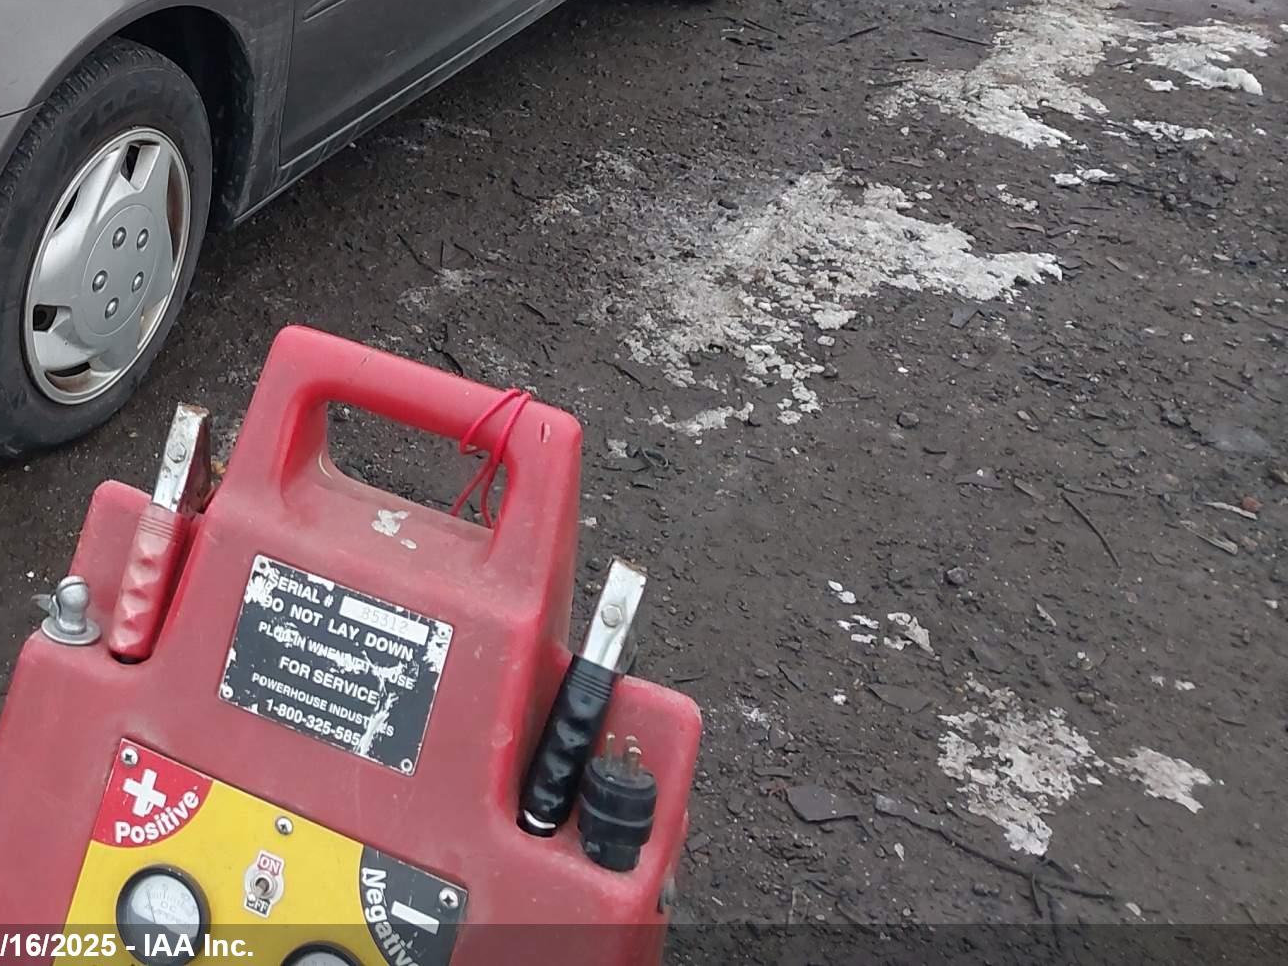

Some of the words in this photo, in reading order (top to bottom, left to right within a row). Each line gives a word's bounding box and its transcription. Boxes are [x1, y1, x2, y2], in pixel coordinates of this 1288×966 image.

[269, 574, 321, 604] SERIAL
[323, 594, 334, 608] #
[289, 604, 323, 626] NOT
[327, 618, 360, 641] LAY
[364, 632, 414, 661] DOWN
[252, 672, 328, 711] POWERHOUSE
[328, 703, 394, 737] INDUSTES
[279, 656, 311, 679] FOR
[312, 669, 379, 705] SERVICE
[266, 698, 367, 747] 1-800-325-585
[115, 791, 200, 843] Positive
[260, 856, 281, 875] ON
[362, 867, 420, 966] Negativ
